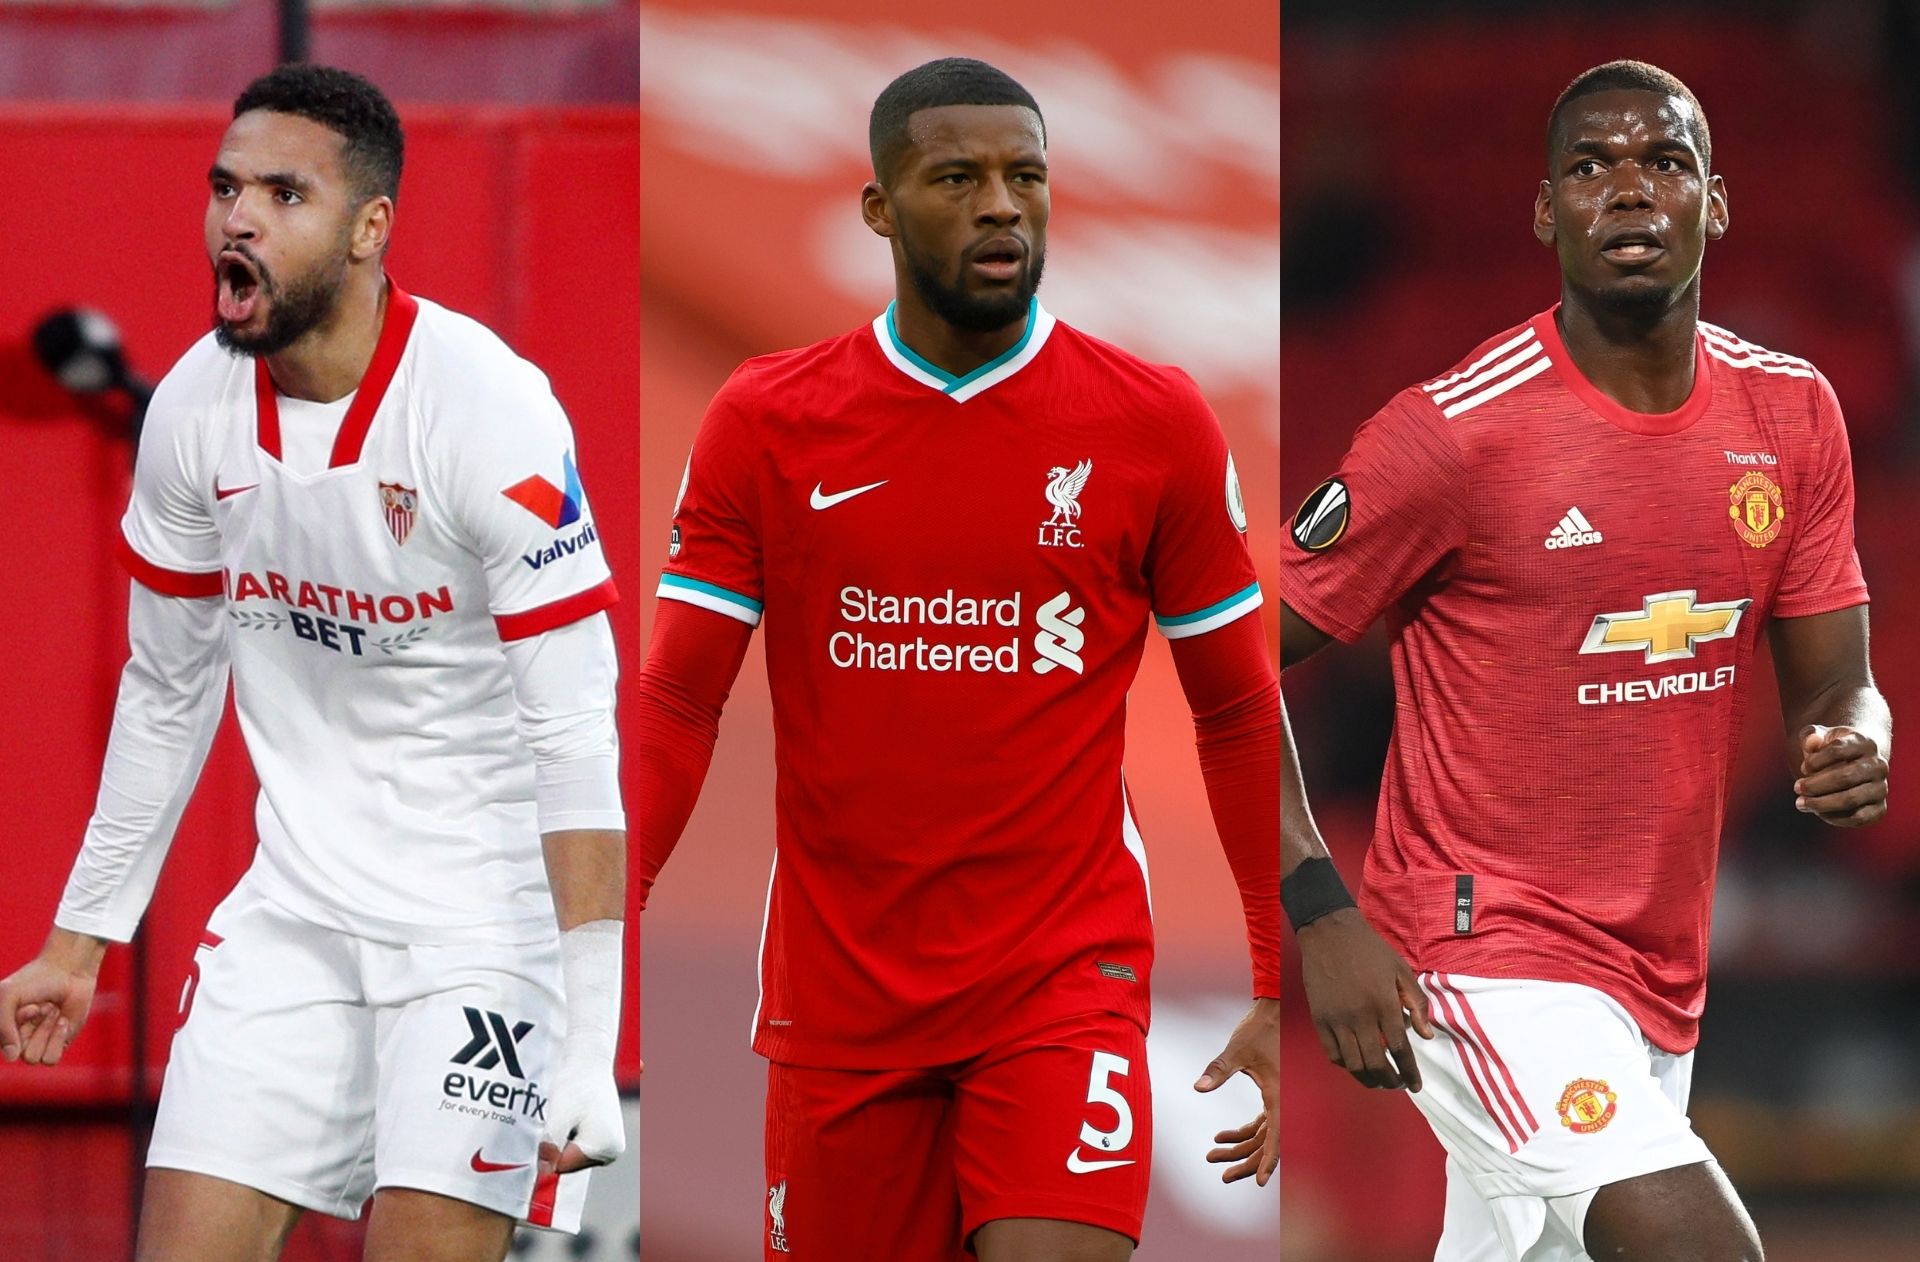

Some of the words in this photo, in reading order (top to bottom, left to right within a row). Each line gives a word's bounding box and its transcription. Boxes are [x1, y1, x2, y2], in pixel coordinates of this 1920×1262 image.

[1723, 451, 1757, 464] Thank
[1757, 453, 1777, 464] You
[1733, 475, 1780, 501] MANCHESTER
[1038, 527, 1084, 547] L.F.C.
[1544, 531, 1603, 550] adidas
[1743, 530, 1775, 541] UNITED
[840, 586, 1021, 627] Standard
[289, 610, 366, 656] BET
[829, 631, 1019, 673] Chartered
[1577, 664, 1735, 705] CHEVROLET
[438, 1099, 456, 1111] for
[458, 1105, 490, 1119] every
[491, 1110, 517, 1126] trade
[443, 1072, 547, 1121] everfx
[1079, 1050, 1133, 1152] 5
